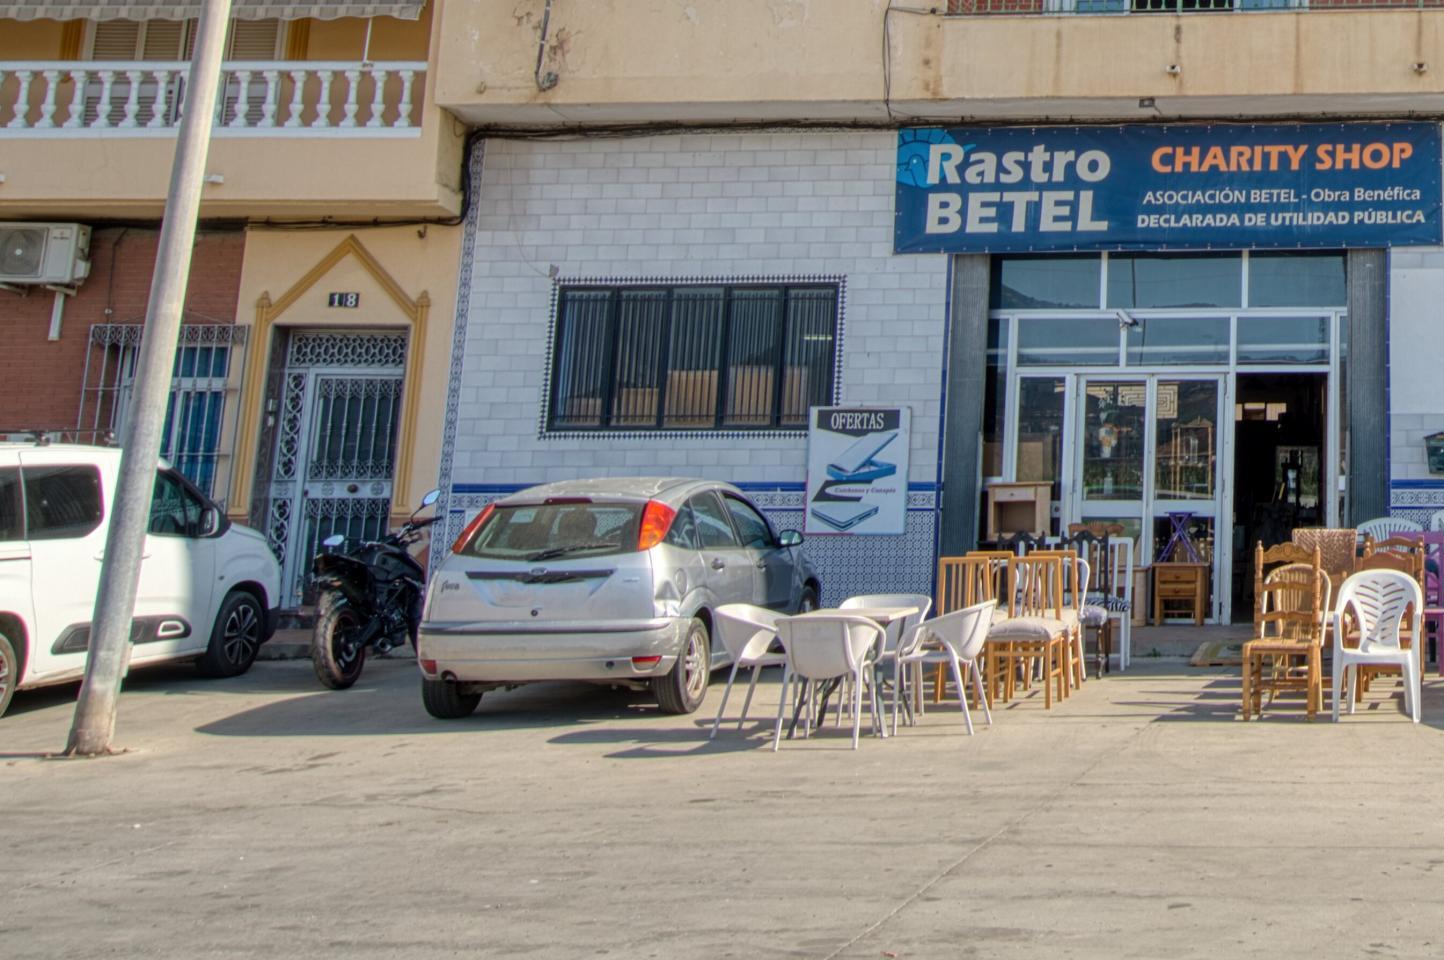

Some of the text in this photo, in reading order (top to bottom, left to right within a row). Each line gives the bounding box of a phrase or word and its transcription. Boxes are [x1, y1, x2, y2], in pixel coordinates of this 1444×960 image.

[926, 143, 1111, 185] Rastro
[1151, 142, 1413, 173] CHARITY SHOP
[1142, 187, 1246, 205] ASOCIACIÓN
[1250, 189, 1299, 203] BETEL
[1311, 188, 1349, 202] Obra
[1354, 186, 1421, 202] Benéfica
[925, 190, 1109, 234] BETEL
[1136, 208, 1426, 228] DECLARADA DE UTILIDAD PÚBLICA
[333, 292, 357, 307] 18
[831, 412, 885, 430] OFERTAS
